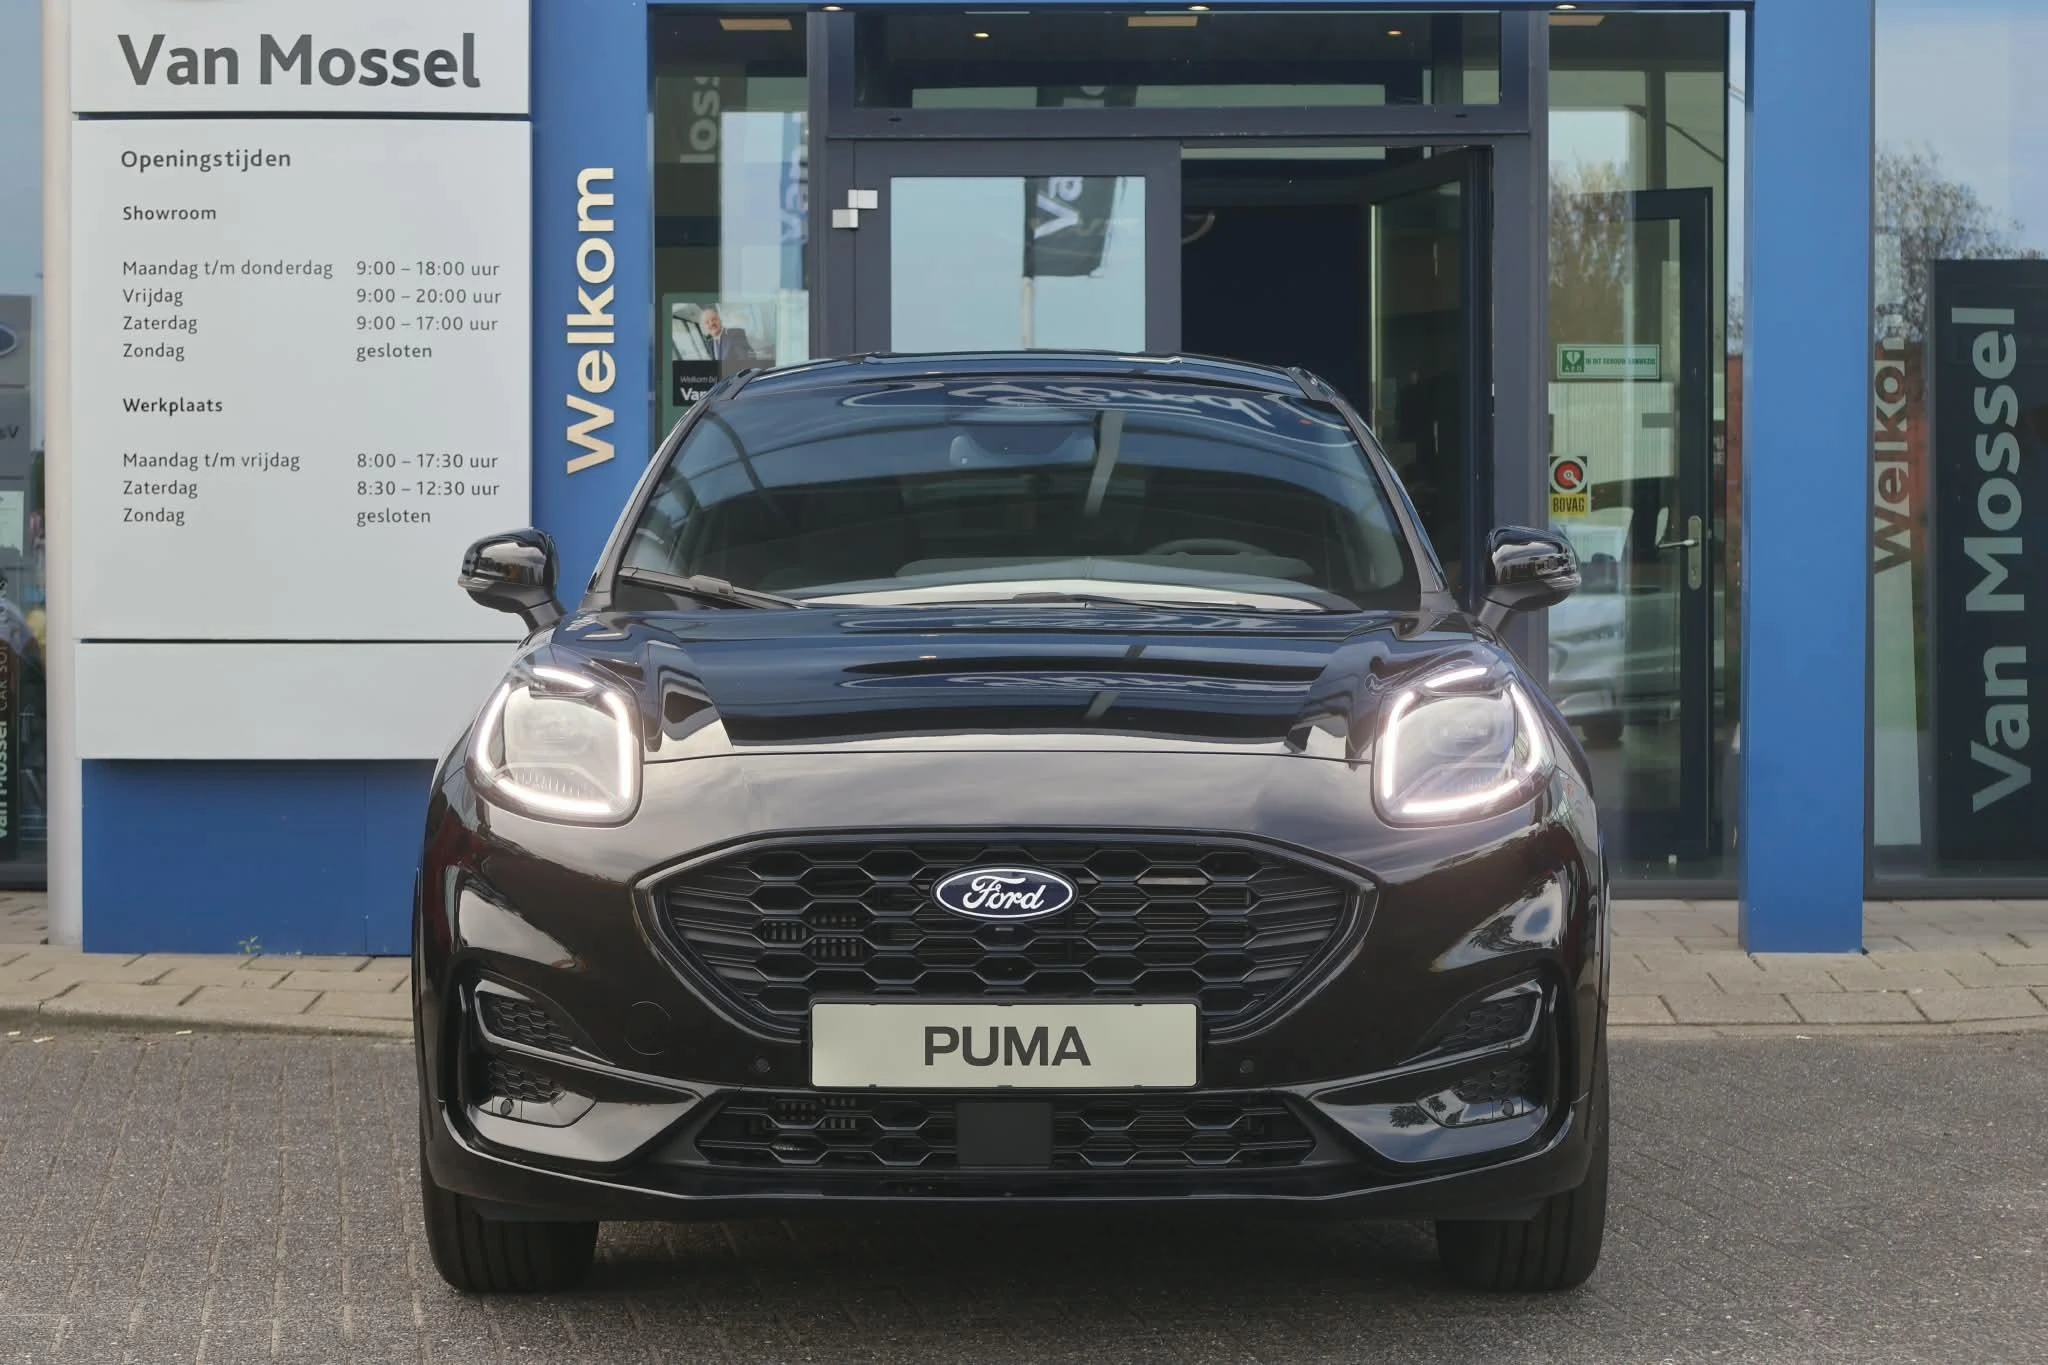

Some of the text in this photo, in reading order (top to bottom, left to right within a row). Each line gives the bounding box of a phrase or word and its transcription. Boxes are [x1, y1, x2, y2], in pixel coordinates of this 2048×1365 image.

[117, 32, 482, 88] Van Mossel
[120, 148, 291, 174] Openingstijden
[122, 204, 217, 221] Showroom
[122, 259, 199, 280] Maandag
[203, 259, 235, 276] t/m
[240, 259, 334, 280] donderdag
[356, 260, 396, 276] 9:00
[415, 260, 465, 276] 18:00
[471, 265, 501, 277] uur
[122, 287, 184, 308] Vrijdag
[356, 287, 396, 304] 9:00
[415, 288, 467, 304] 20:00
[472, 292, 502, 304] uur
[122, 314, 198, 335] Zaterdag
[356, 315, 396, 331] 9:00
[416, 315, 464, 331] 17:00
[469, 319, 499, 332] uur
[566, 167, 616, 475] Welkom
[122, 341, 433, 363] Zondag gesloten
[121, 396, 223, 417] Werkplaats
[123, 451, 199, 473] Maandag
[203, 451, 236, 468] t/m
[240, 451, 301, 473] vrijdag
[357, 452, 397, 469] 8:00
[416, 453, 464, 469] 17:30
[469, 456, 499, 469] uur
[122, 479, 199, 500] Zaterdag
[357, 480, 396, 496] 8:30
[416, 480, 465, 496] 12:30
[471, 484, 501, 496] uur
[1552, 497, 1585, 513] BOVAG
[123, 506, 431, 528] Zondag gesloten
[1951, 307, 2032, 814] Van Mossel
[962, 875, 1047, 910] Ford
[924, 1025, 1092, 1067] PUMA
